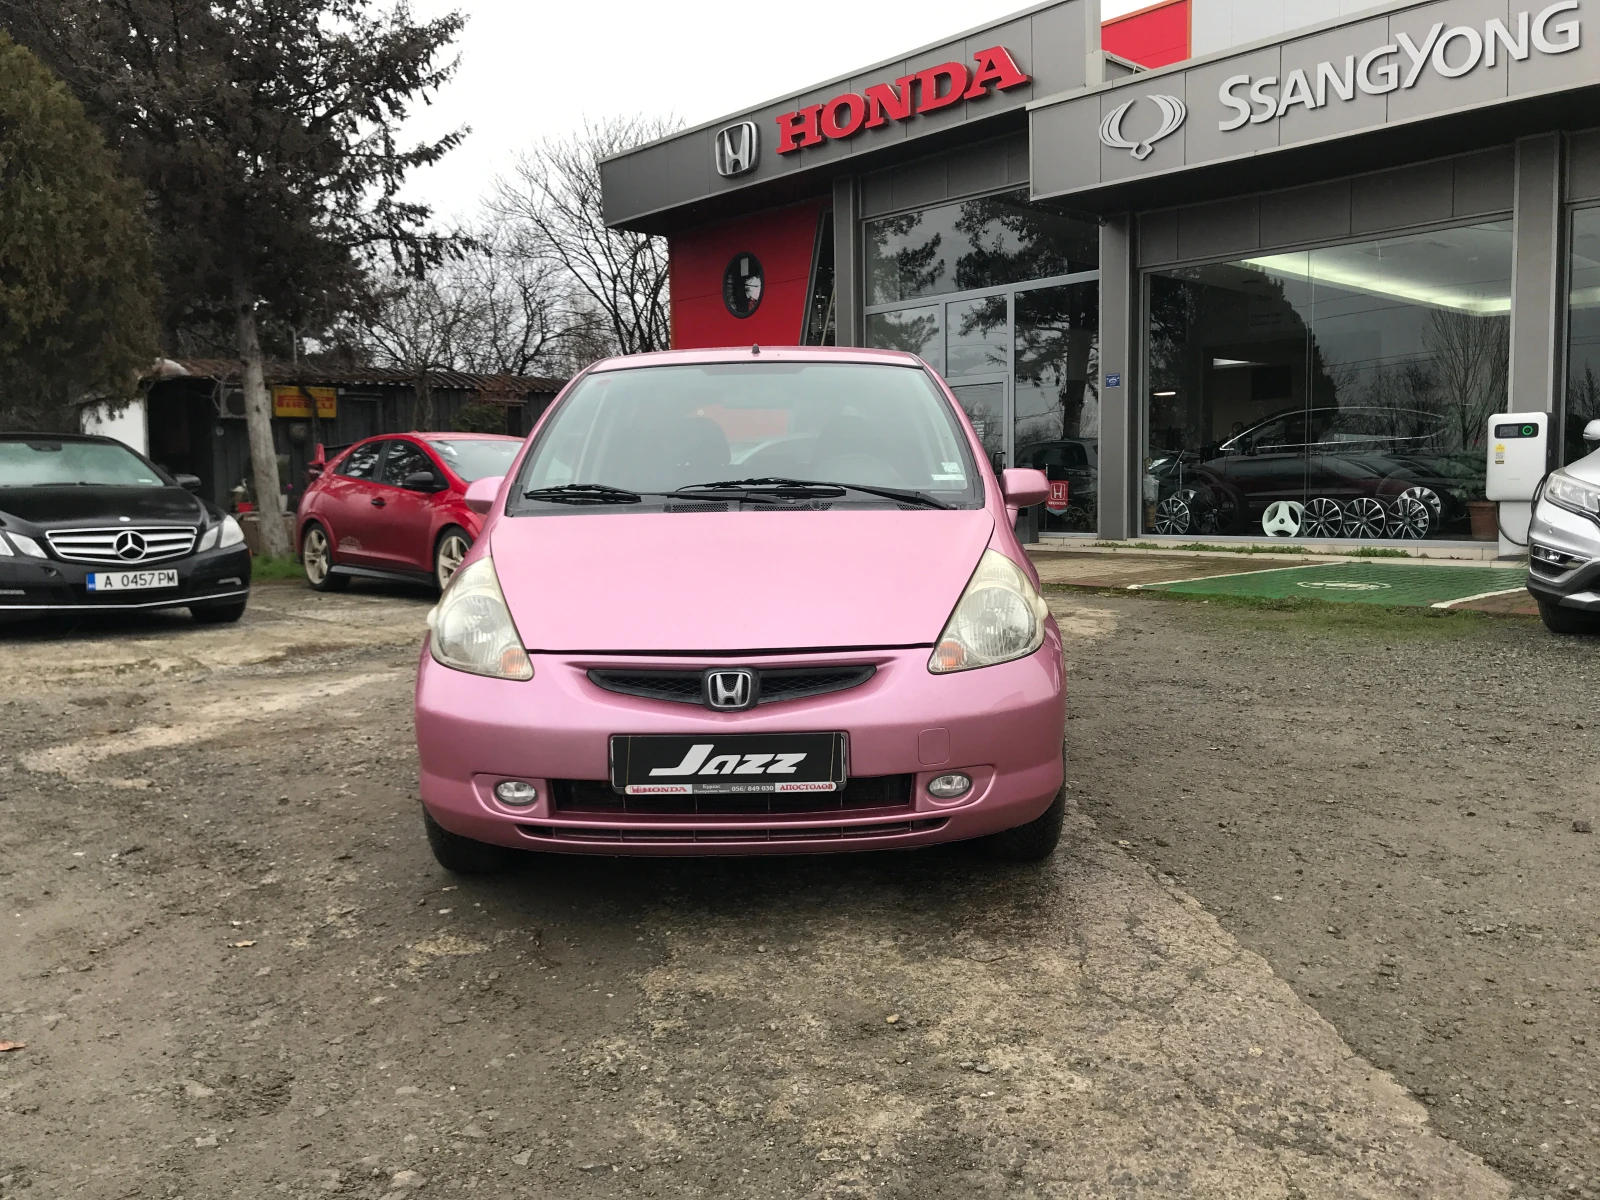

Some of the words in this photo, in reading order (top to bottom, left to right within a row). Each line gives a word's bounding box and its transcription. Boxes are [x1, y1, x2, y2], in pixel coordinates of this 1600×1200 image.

[776, 45, 1033, 155] HONDA
[761, 784, 774, 792] 030
[780, 783, 833, 792] АПОСТОЛОВ
